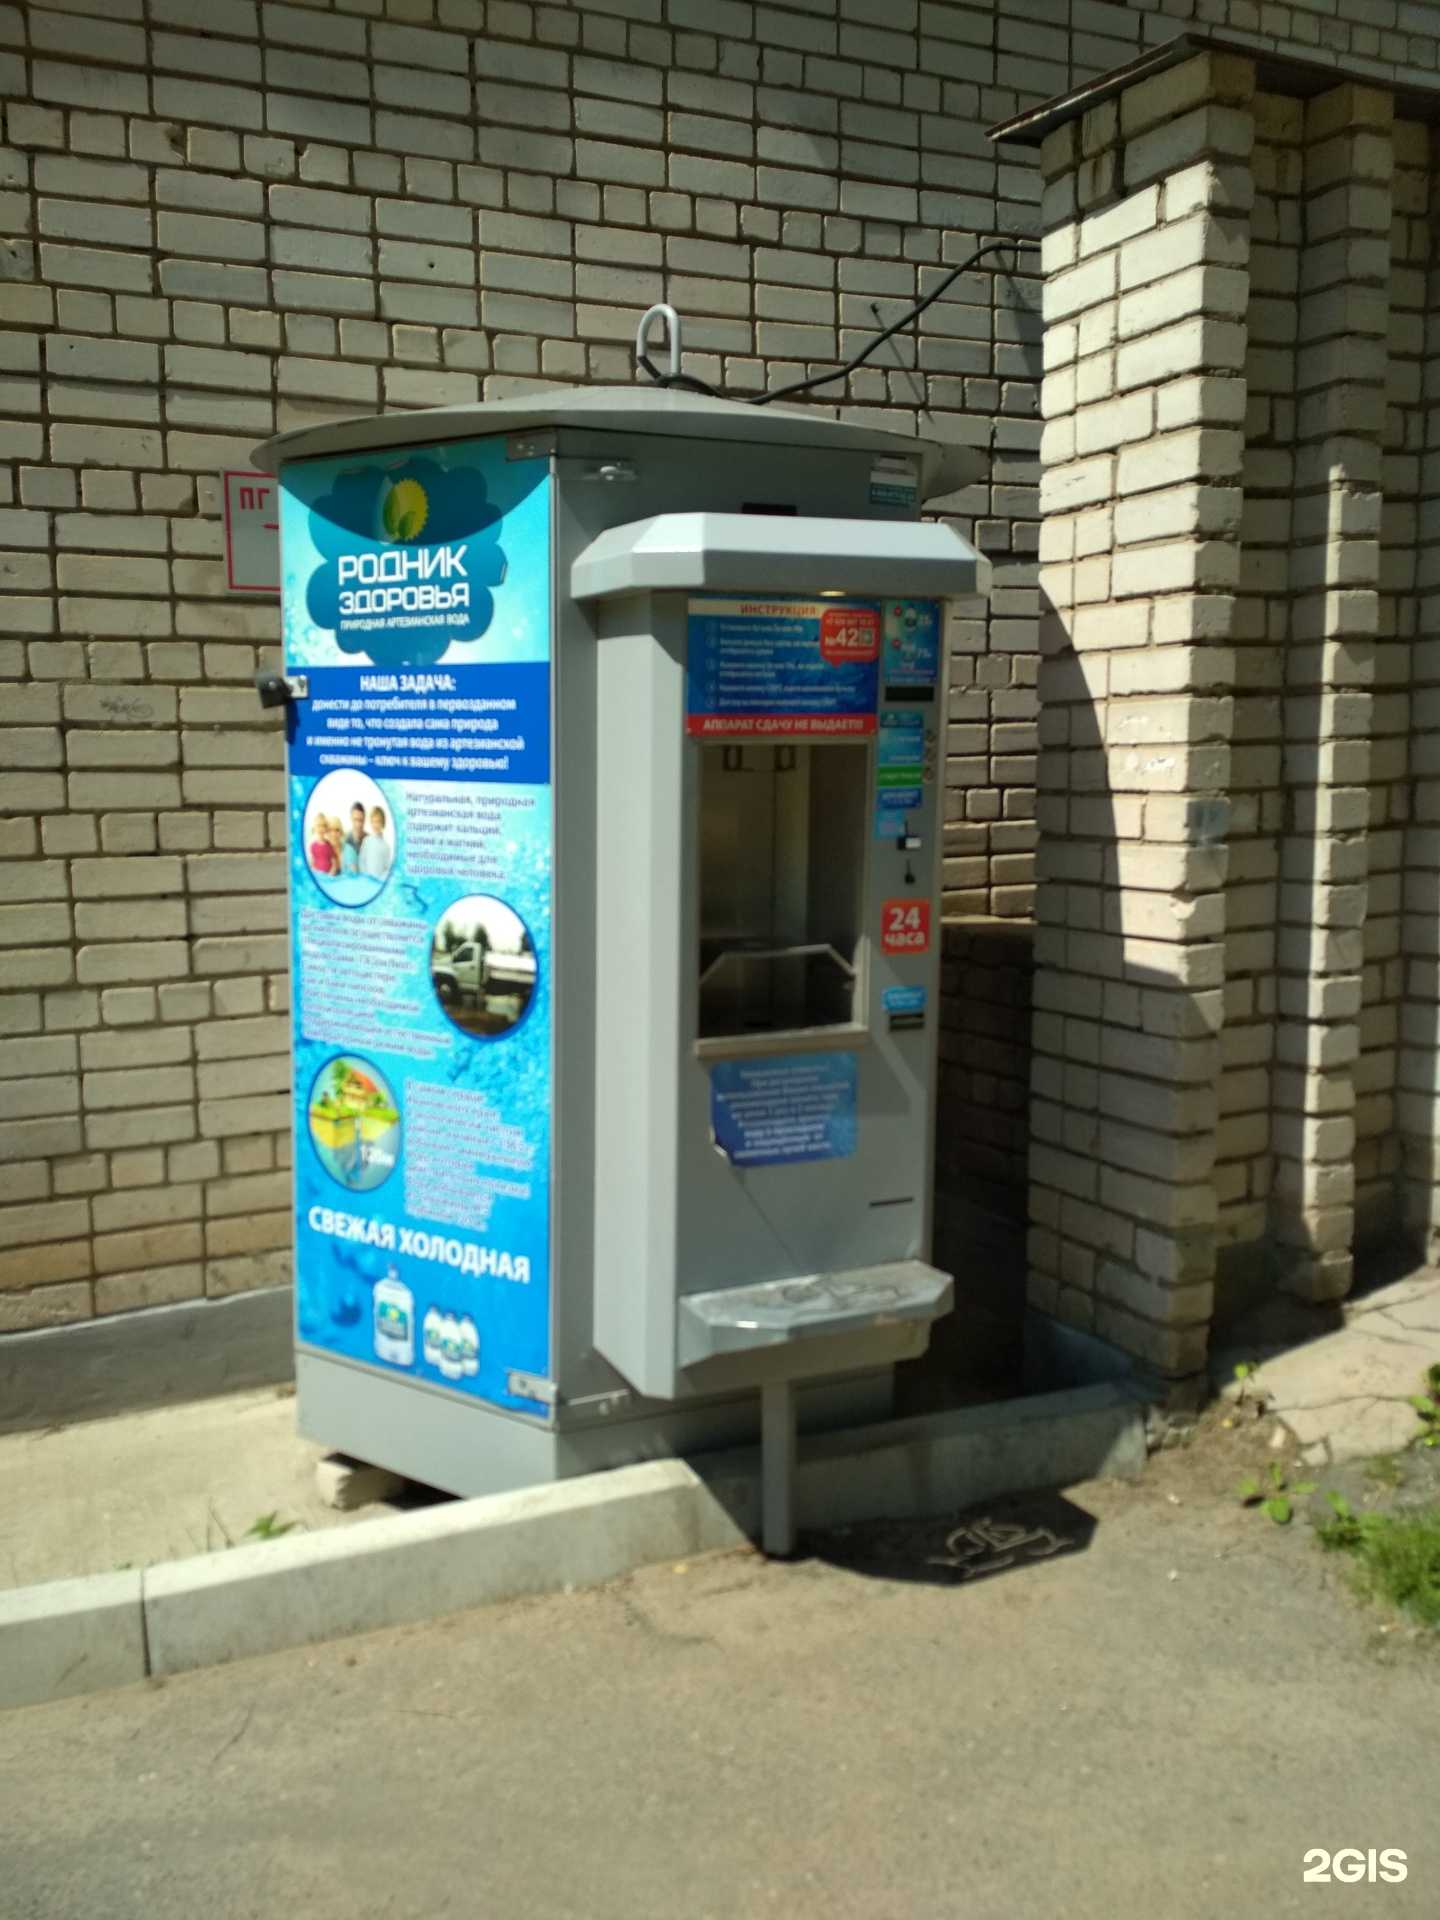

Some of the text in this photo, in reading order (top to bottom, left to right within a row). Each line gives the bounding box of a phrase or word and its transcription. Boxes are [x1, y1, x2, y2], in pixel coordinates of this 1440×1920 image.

[239, 486, 270, 511] ПГ
[338, 545, 468, 586] РОДНИК
[338, 582, 470, 615] ЗДОРОВЬЯ
[740, 605, 816, 616] ИНСТРУКЦИЯ
[340, 612, 470, 631] ПРИРОДНАЯ АРТЕЗИАНСКАЯ ВОДА
[360, 674, 457, 694] НАША ЗАДАЧА:
[350, 699, 363, 712] до
[364, 696, 428, 713] потребителя
[437, 699, 517, 714] первозданном
[365, 718, 382, 730] что
[383, 718, 423, 732] создала
[424, 718, 449, 730] сама
[451, 718, 499, 733] природа
[704, 719, 752, 730] АППАРАТ
[755, 719, 794, 730] СДАЧУ
[795, 719, 809, 729] НЕ
[314, 736, 349, 747] именно
[409, 737, 434, 751] вода
[449, 735, 525, 753] артезианской
[450, 755, 509, 772] здоровью!
[475, 796, 535, 808] природная
[889, 907, 920, 931] 24
[884, 931, 925, 947] часа
[308, 1206, 396, 1250] СВЕЖАЯ
[399, 1228, 531, 1284] ХОЛОДНАЯ
